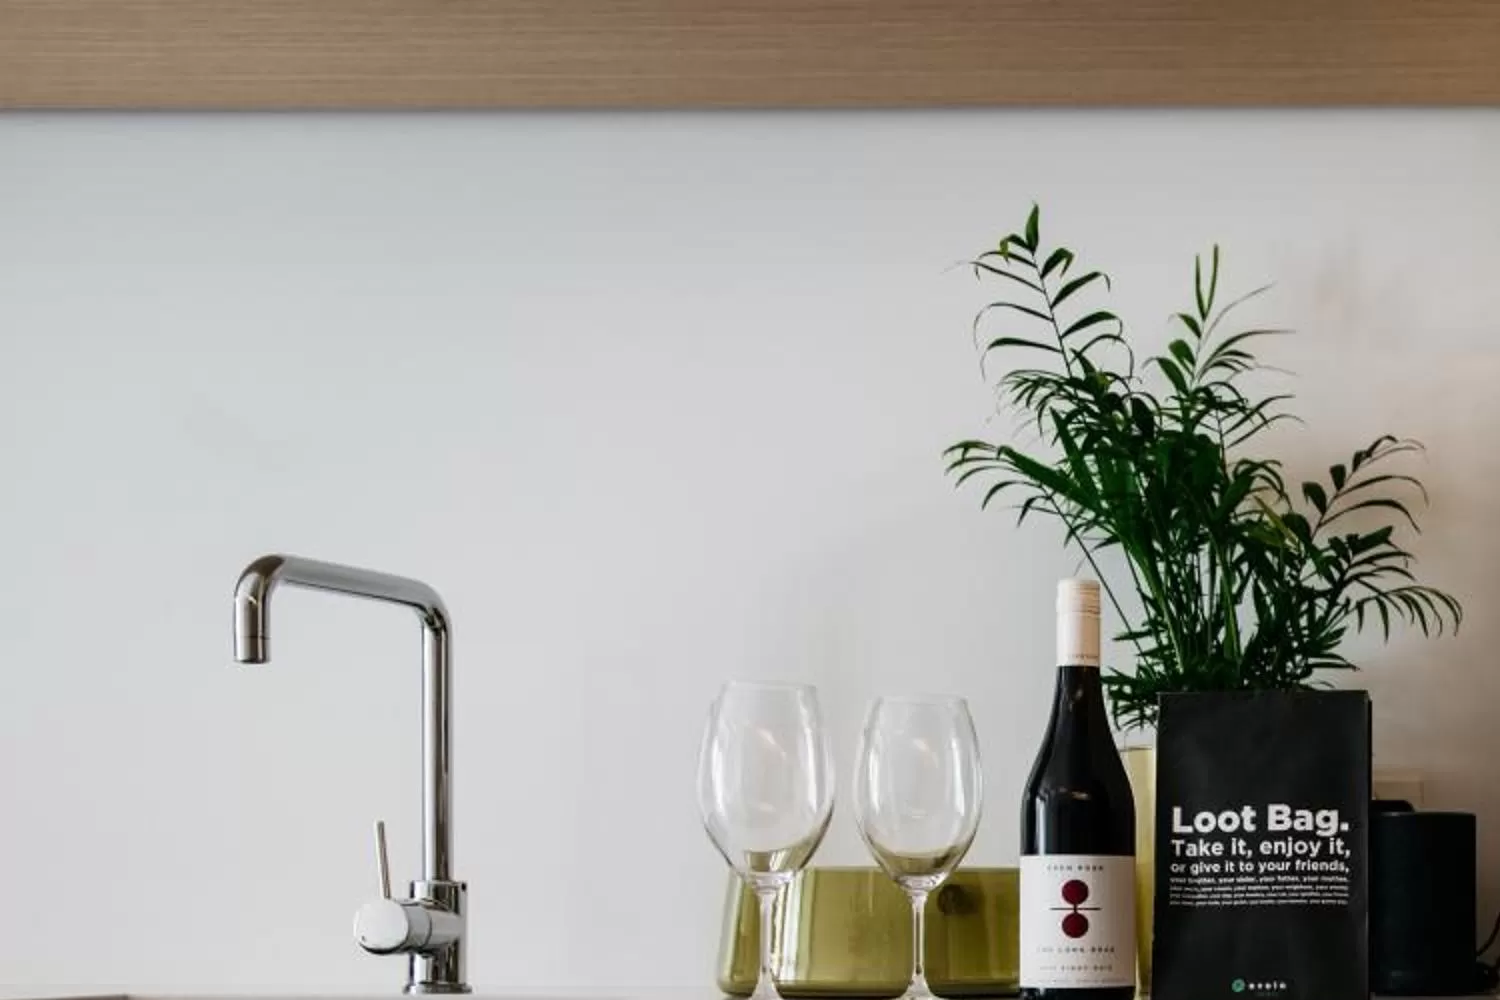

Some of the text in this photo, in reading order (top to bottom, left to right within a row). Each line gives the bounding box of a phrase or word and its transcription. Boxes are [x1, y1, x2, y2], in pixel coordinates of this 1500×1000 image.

[1172, 803, 1350, 837] Loot Bag.
[1170, 836, 1351, 859] Take it, enjoy it,
[1170, 859, 1350, 875] or give it to your friends,
